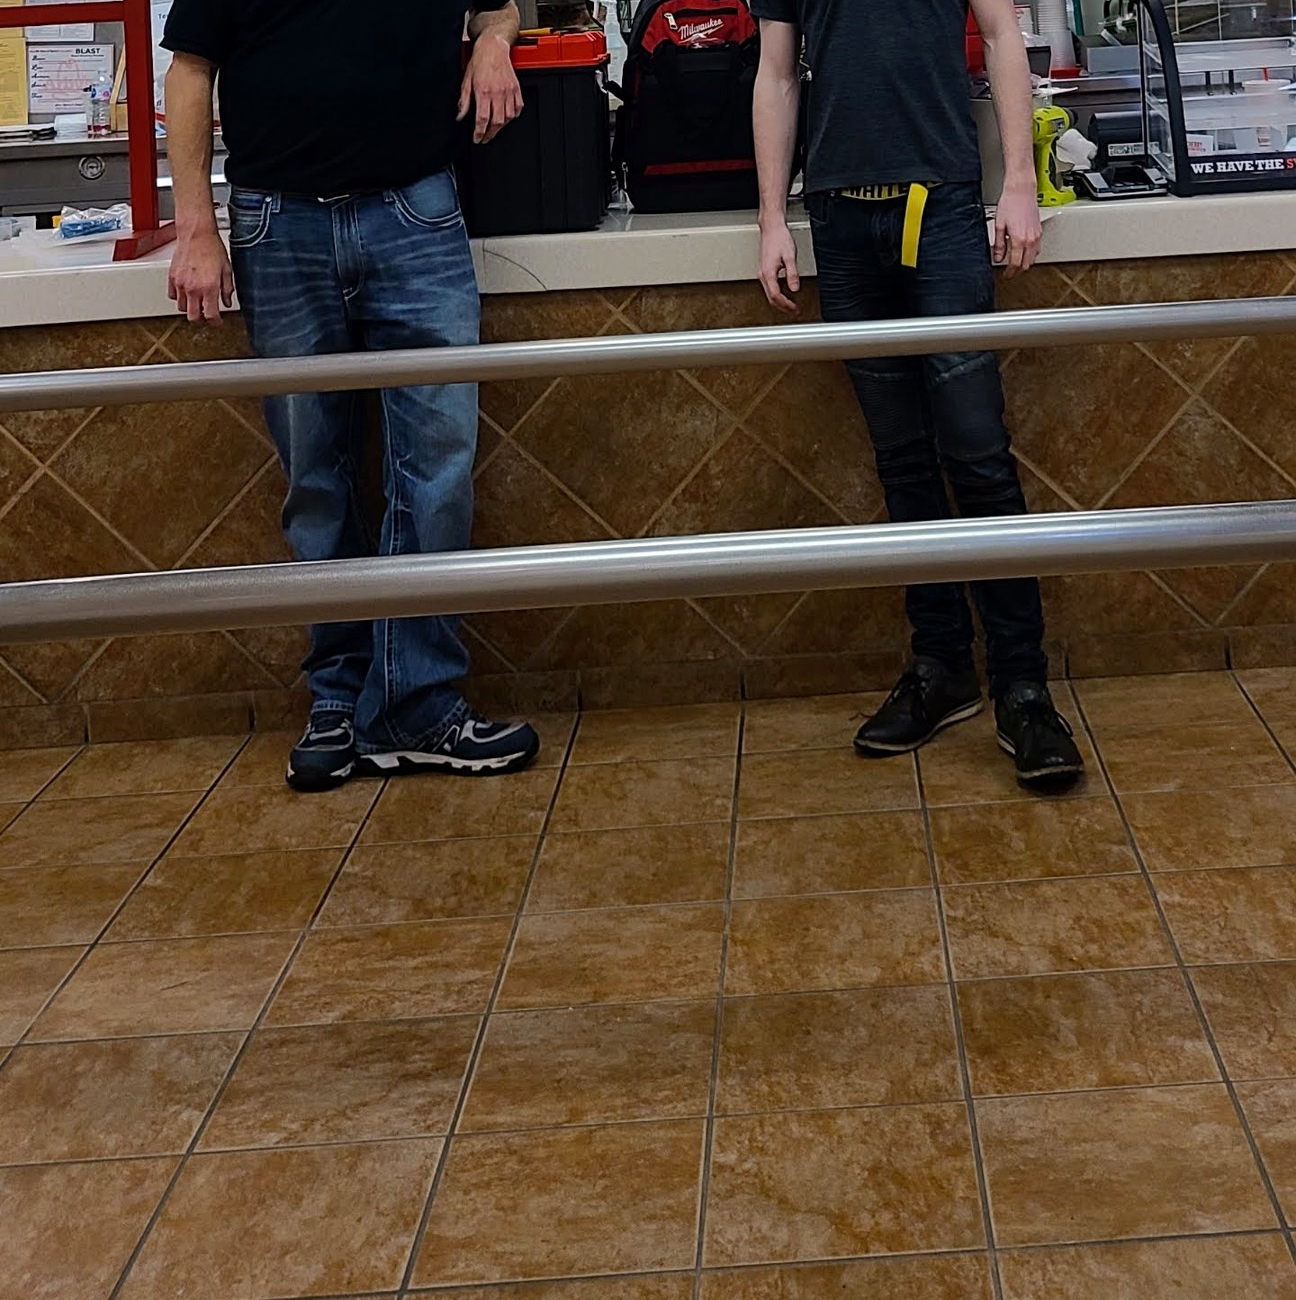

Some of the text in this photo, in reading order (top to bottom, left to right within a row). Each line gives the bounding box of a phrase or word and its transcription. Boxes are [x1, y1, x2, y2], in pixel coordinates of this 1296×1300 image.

[678, 18, 723, 40] Milwaukee
[1191, 163, 1214, 174] WE
[1216, 161, 1254, 173] HAVE
[1255, 159, 1284, 171] THE
